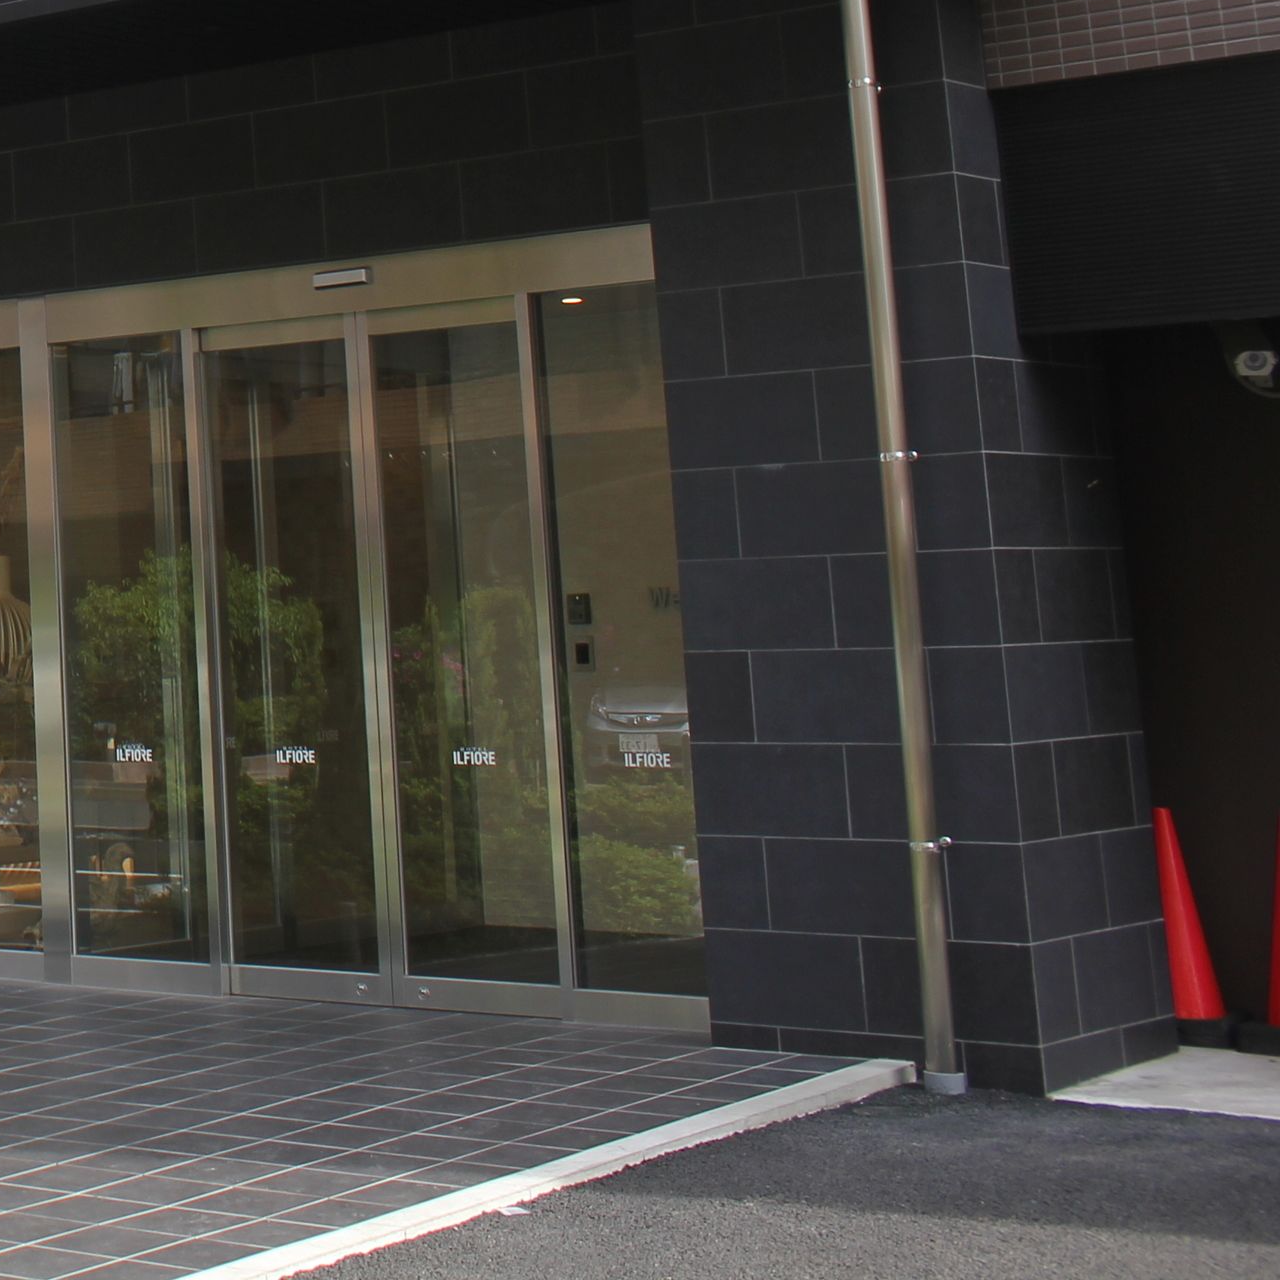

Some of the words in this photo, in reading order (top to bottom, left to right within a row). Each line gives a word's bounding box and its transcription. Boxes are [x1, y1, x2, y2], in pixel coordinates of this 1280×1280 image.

[115, 748, 153, 762] ILFIORE
[276, 749, 316, 764] ILFIORE
[452, 750, 497, 766] ILFIORE
[624, 752, 672, 768] ILFIORE
